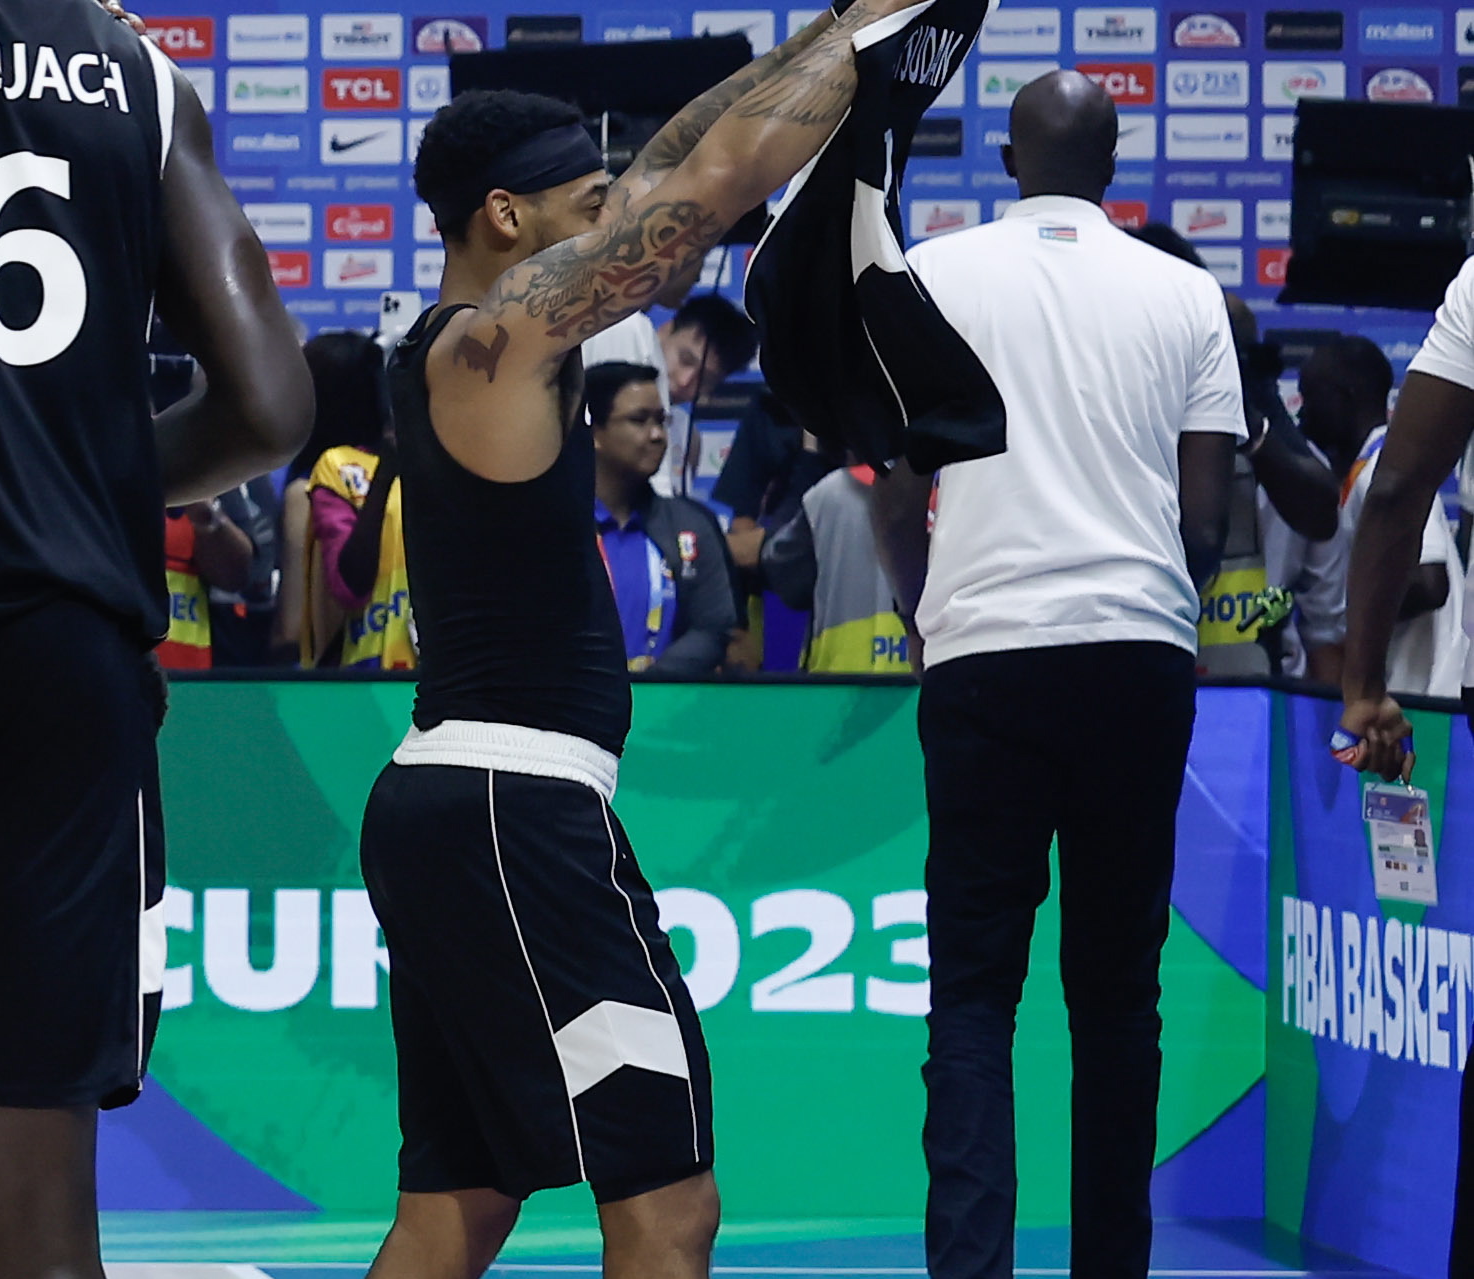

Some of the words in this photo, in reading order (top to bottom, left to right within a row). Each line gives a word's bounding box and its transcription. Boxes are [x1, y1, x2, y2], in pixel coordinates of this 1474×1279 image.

[330, 78, 393, 102] TCL
[1198, 592, 1253, 623] HOT
[1282, 894, 1339, 1042] FIBA
[1341, 910, 1474, 1073] BASKET
